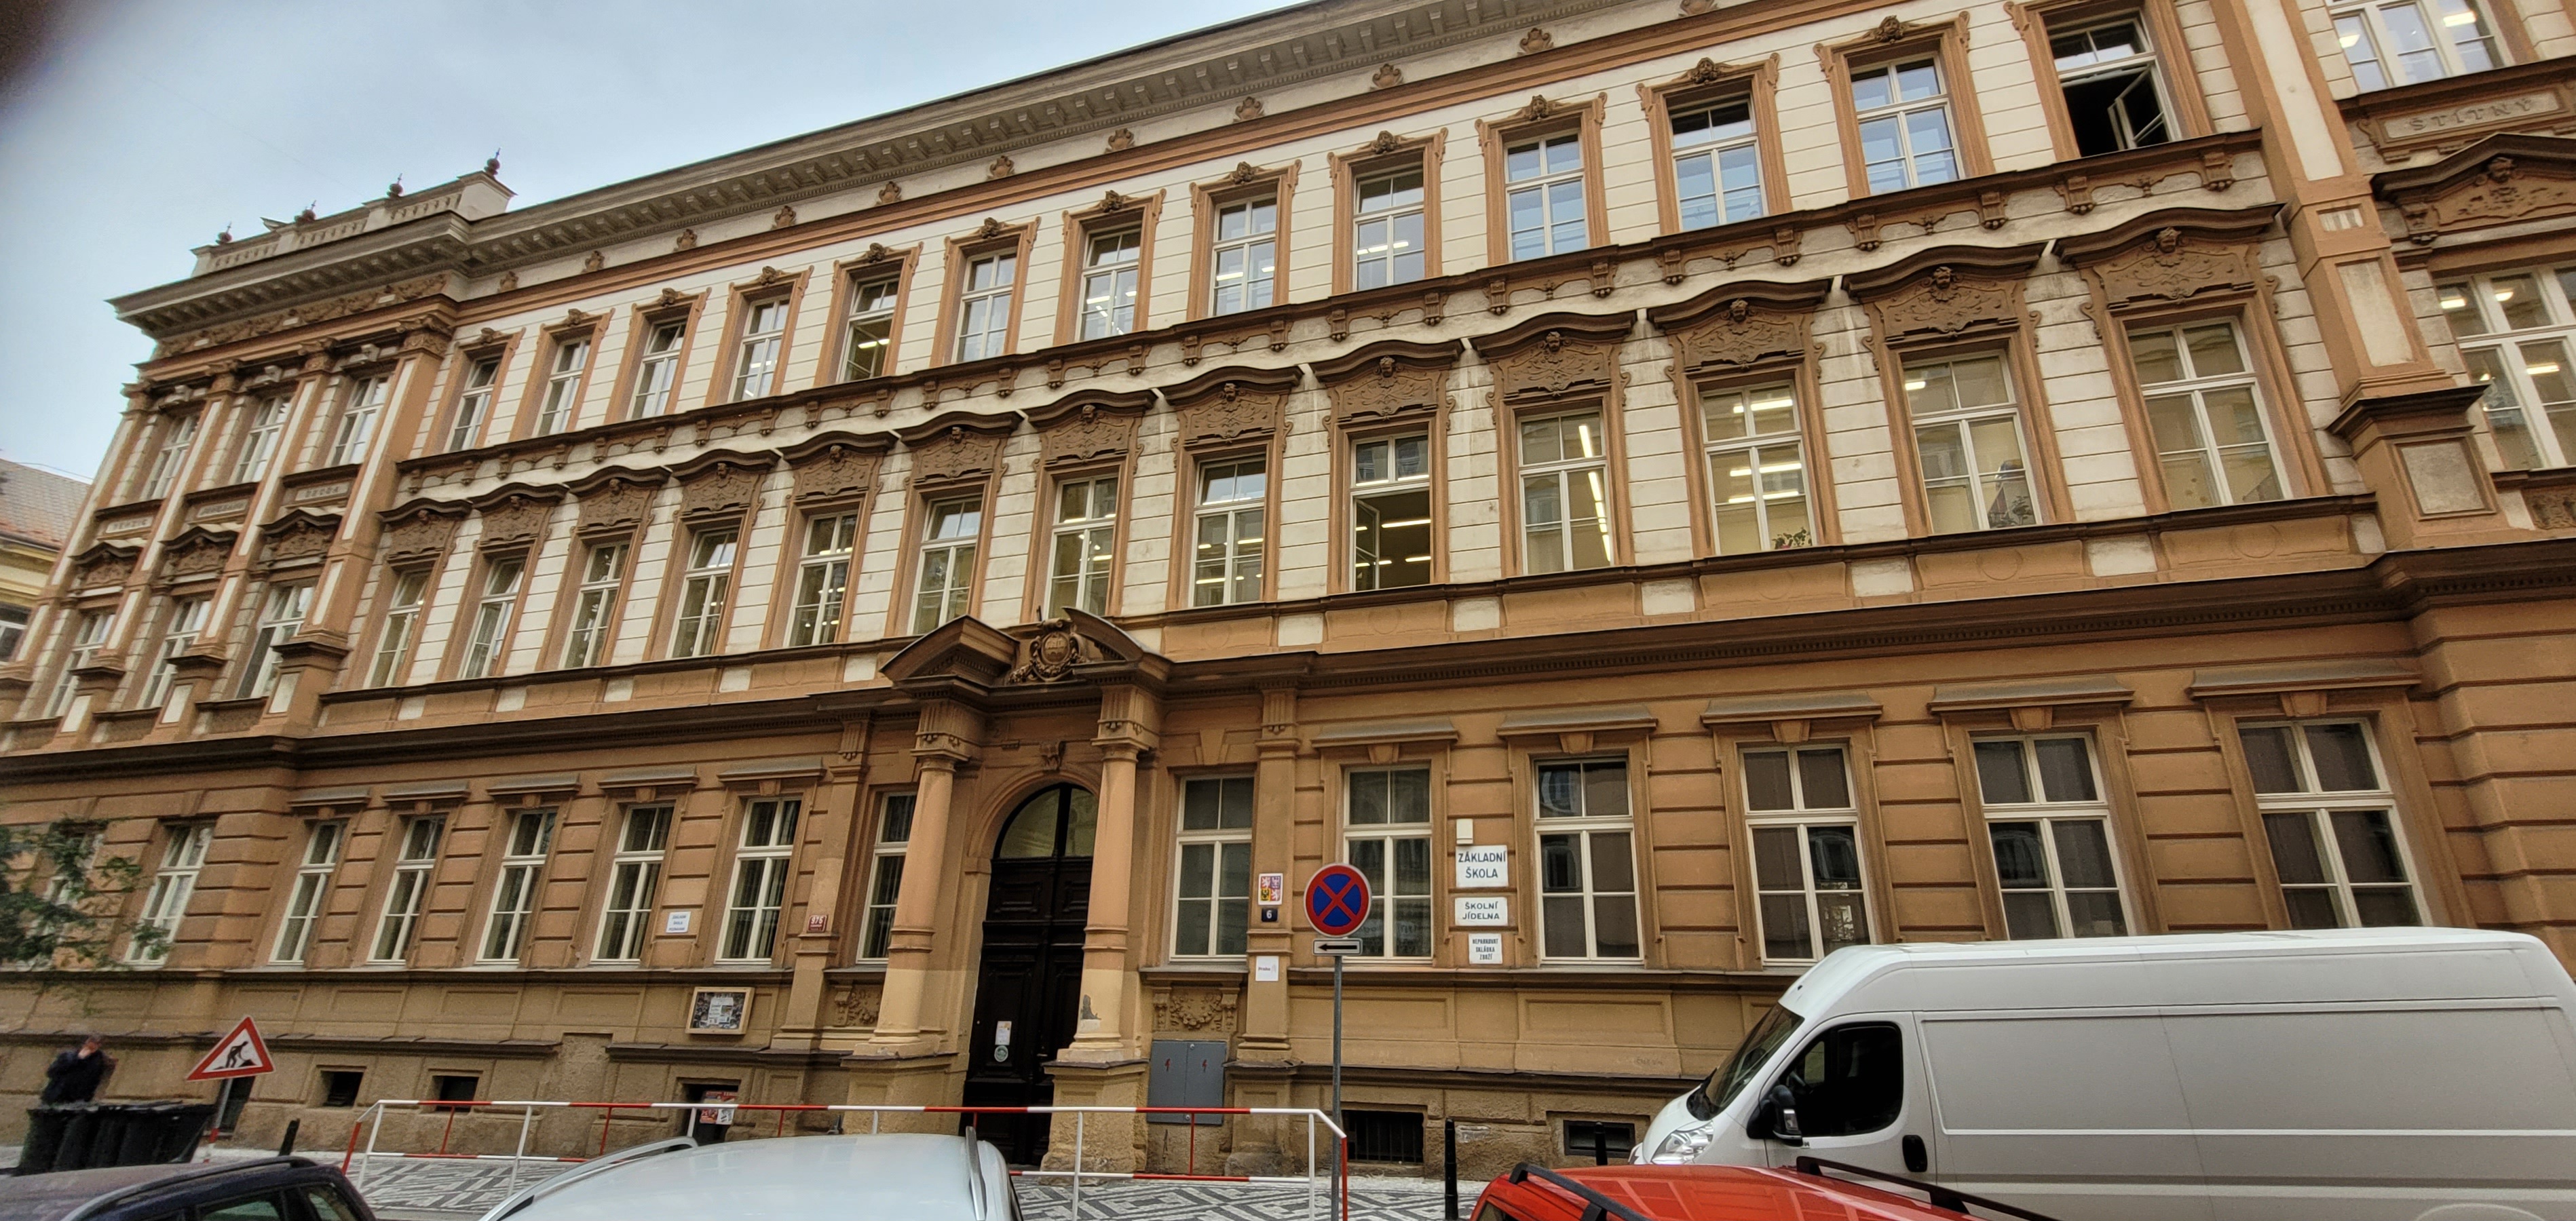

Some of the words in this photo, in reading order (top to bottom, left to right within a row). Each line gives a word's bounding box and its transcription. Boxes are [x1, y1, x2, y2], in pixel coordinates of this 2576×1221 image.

[1458, 850, 1507, 863] ZÁKLADNÍ
[1465, 866, 1498, 878] ŠKOLA
[1464, 901, 1498, 910] ŠKOLNÍ
[1266, 910, 1272, 919] 6
[1462, 911, 1500, 920] JÍDELNA
